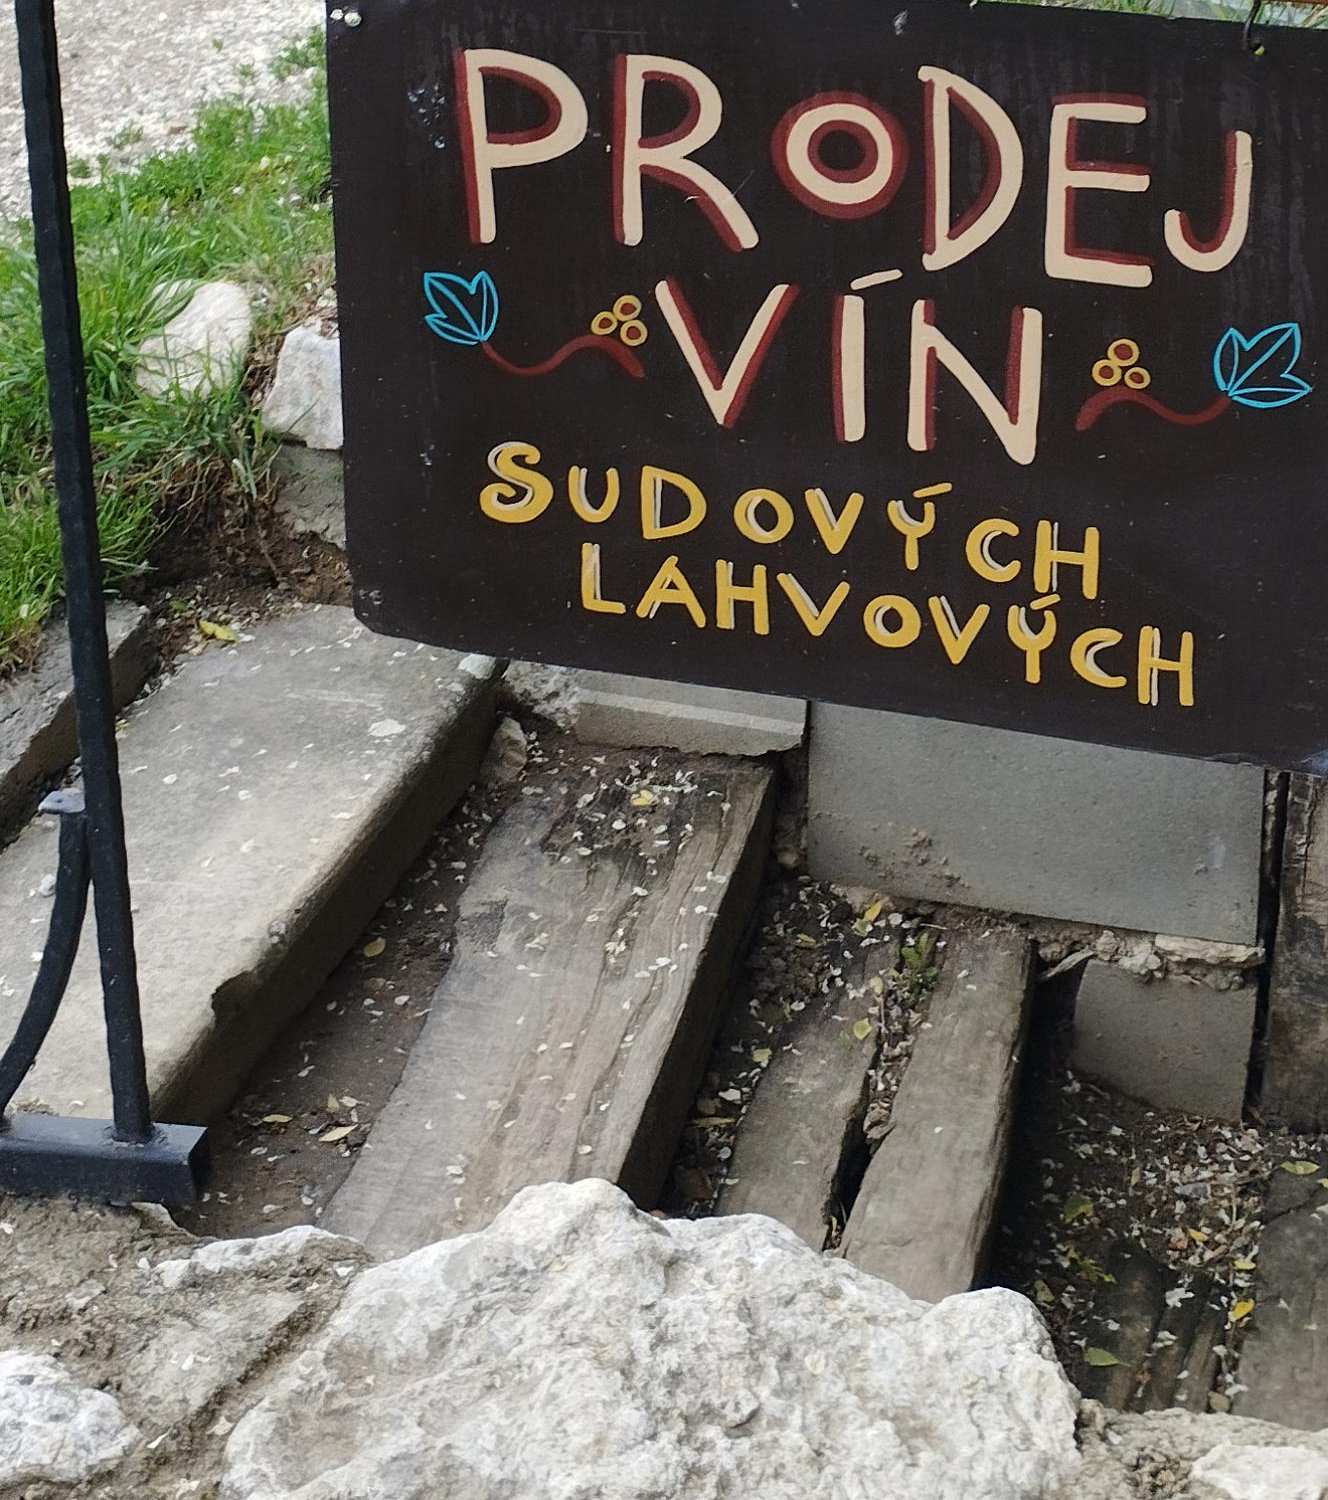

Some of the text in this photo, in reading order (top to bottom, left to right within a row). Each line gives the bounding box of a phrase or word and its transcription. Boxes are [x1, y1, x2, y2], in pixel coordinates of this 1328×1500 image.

[456, 48, 1254, 288] PRODEJ
[655, 269, 1046, 466] VÍN
[478, 440, 1102, 601] SUDOVÝCH
[579, 542, 1196, 708] LAHVOVÝCH
